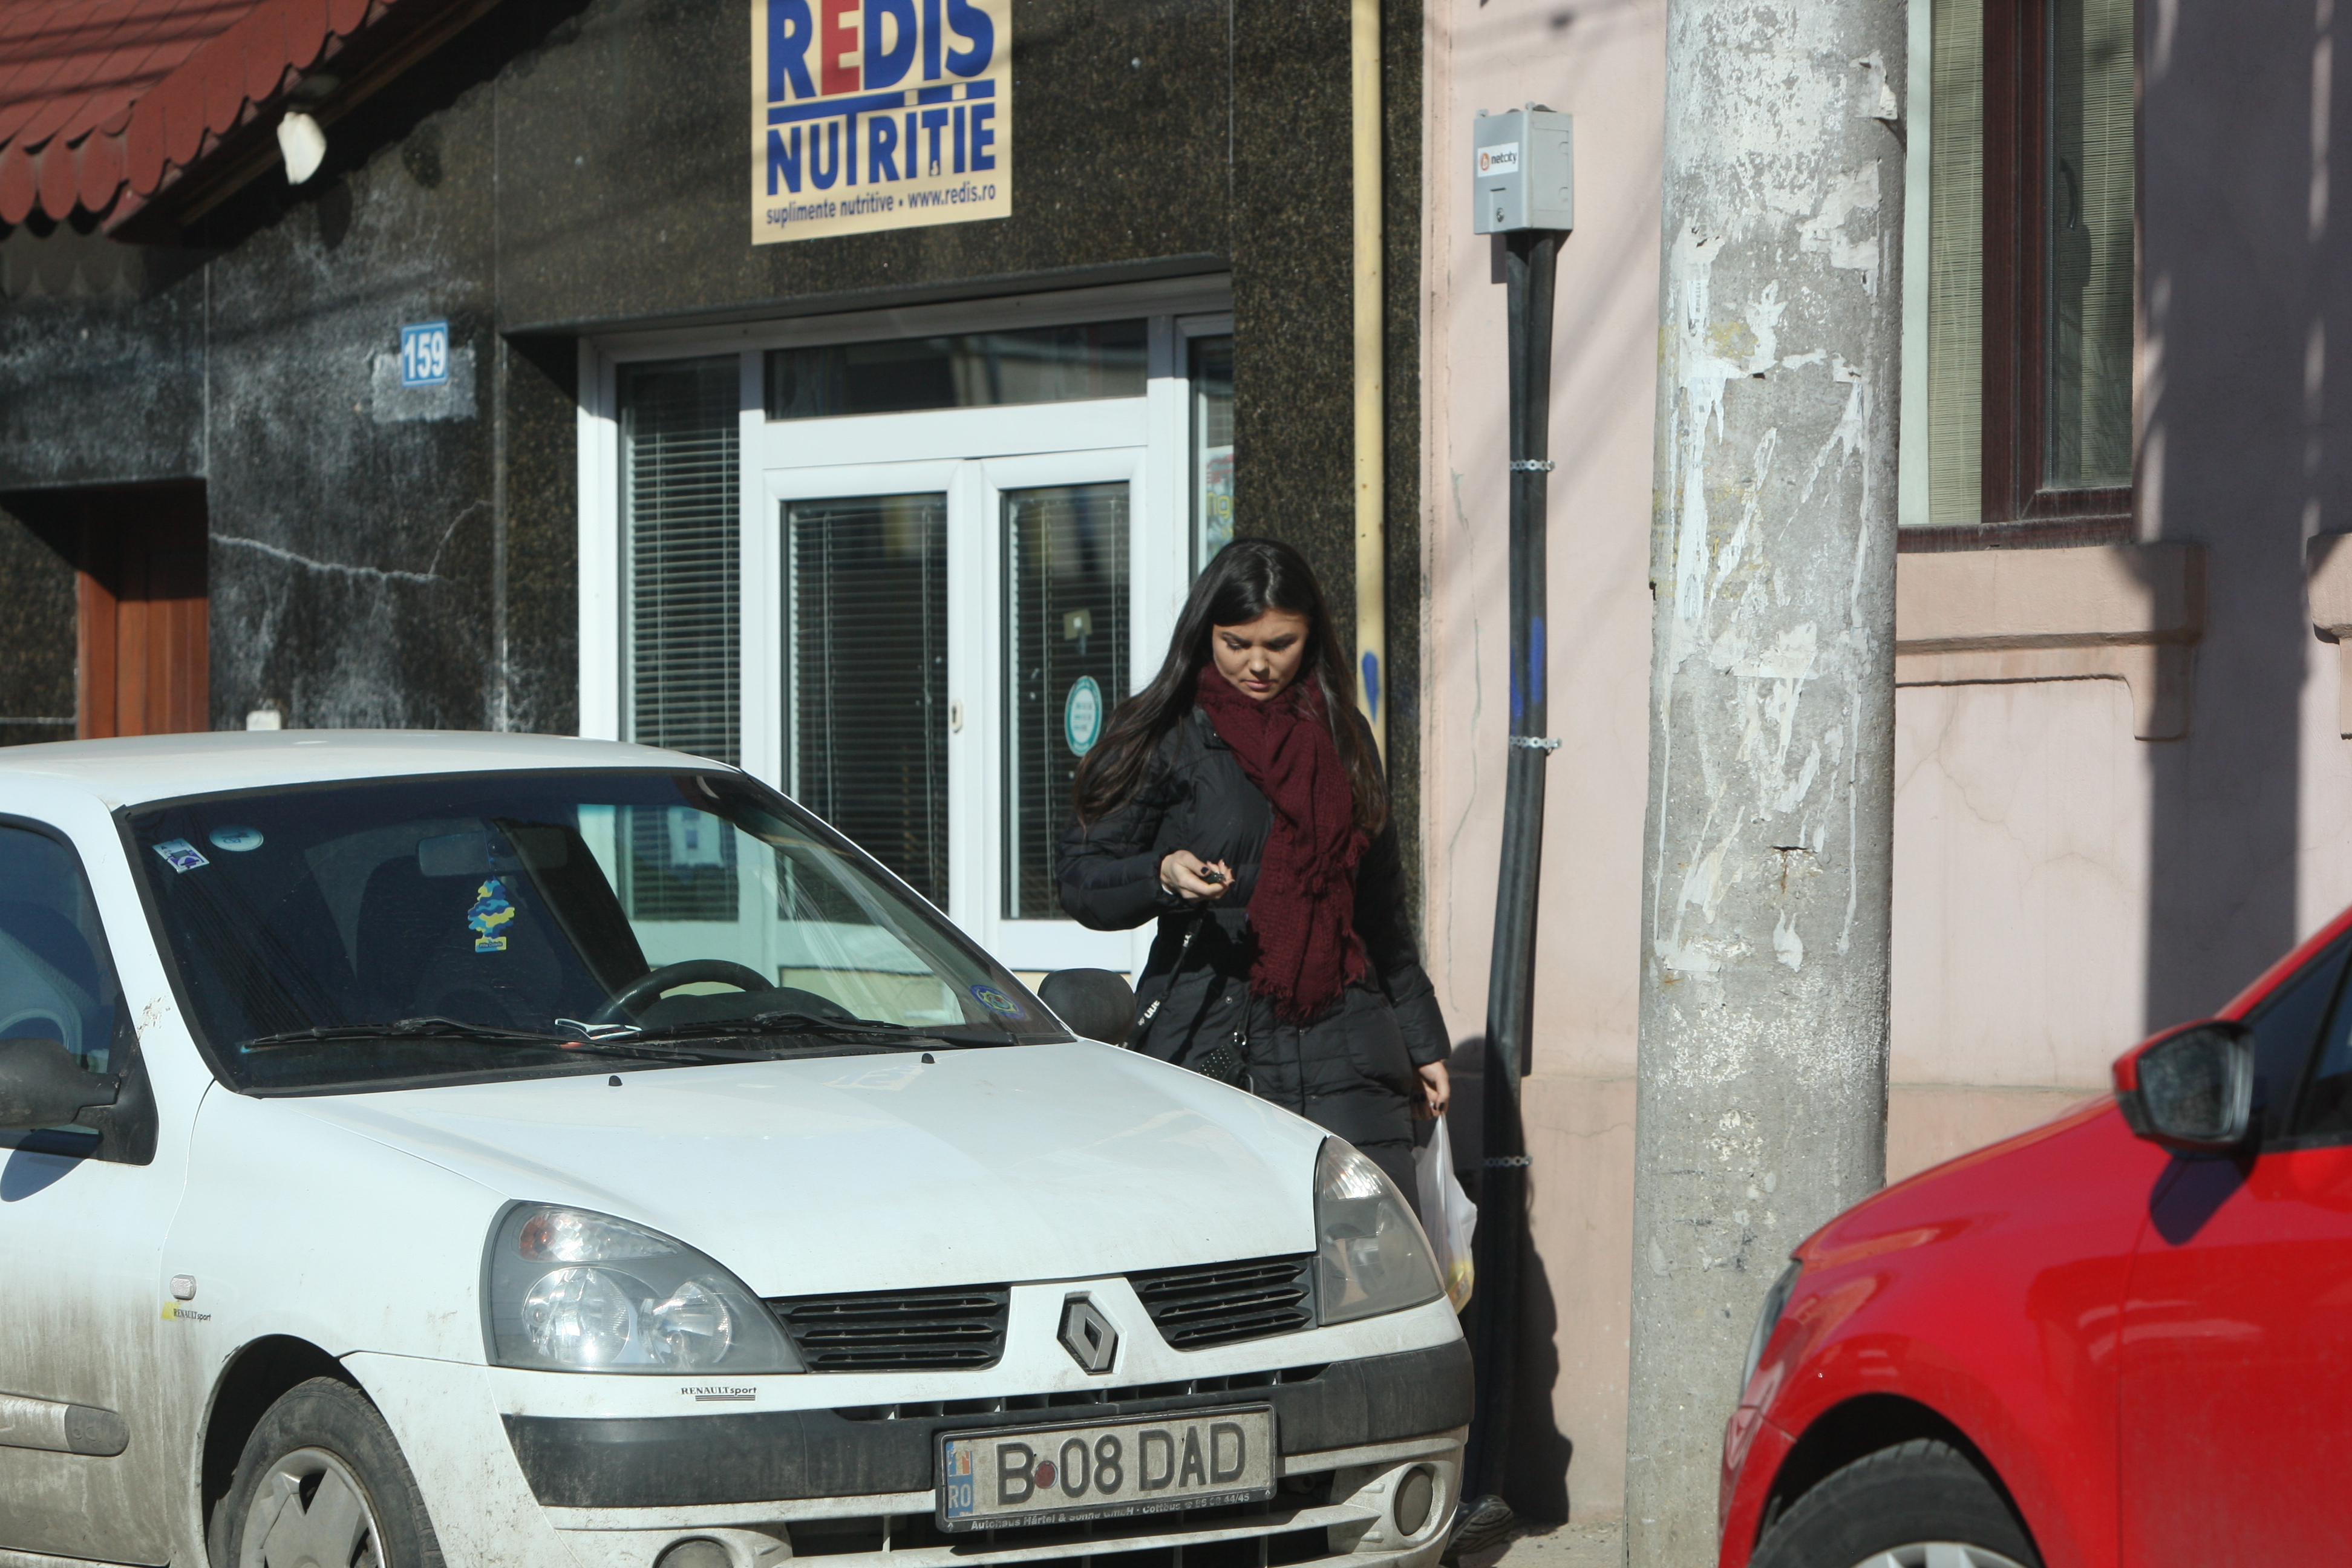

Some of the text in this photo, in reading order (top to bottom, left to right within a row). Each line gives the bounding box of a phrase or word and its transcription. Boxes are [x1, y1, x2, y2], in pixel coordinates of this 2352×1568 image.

[766, 0, 994, 103] REDIS
[766, 102, 996, 197] NUTRITIE
[1491, 151, 1517, 165] netcity
[766, 181, 996, 228] suplimente nutritive www.redis.ro
[404, 331, 446, 379] 159
[996, 1422, 1246, 1505] B 08 DAD
[949, 1484, 971, 1508] RO
